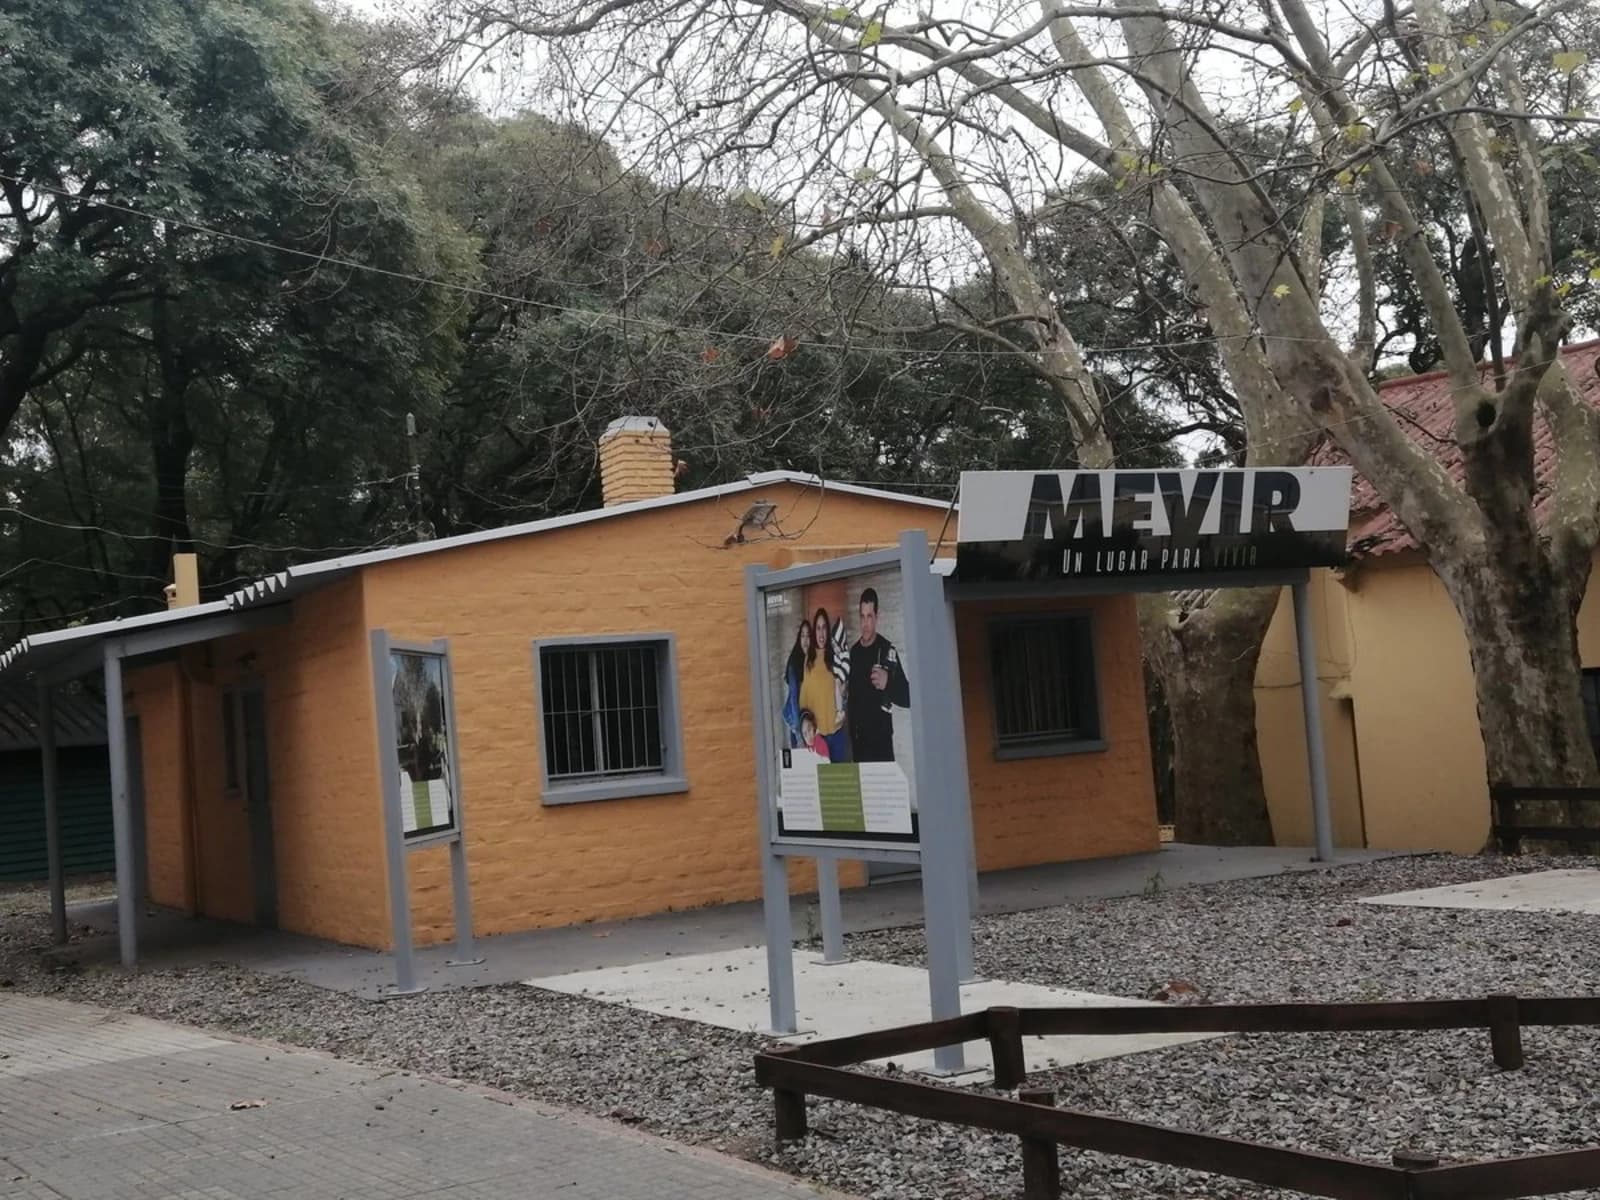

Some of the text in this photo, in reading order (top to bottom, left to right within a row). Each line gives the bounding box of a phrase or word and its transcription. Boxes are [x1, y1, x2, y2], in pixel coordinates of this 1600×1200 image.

[1022, 471, 1301, 540] MEVIR
[1063, 549, 1083, 574] UN
[1096, 550, 1149, 573] LUGAR
[1161, 548, 1201, 569] PARA
